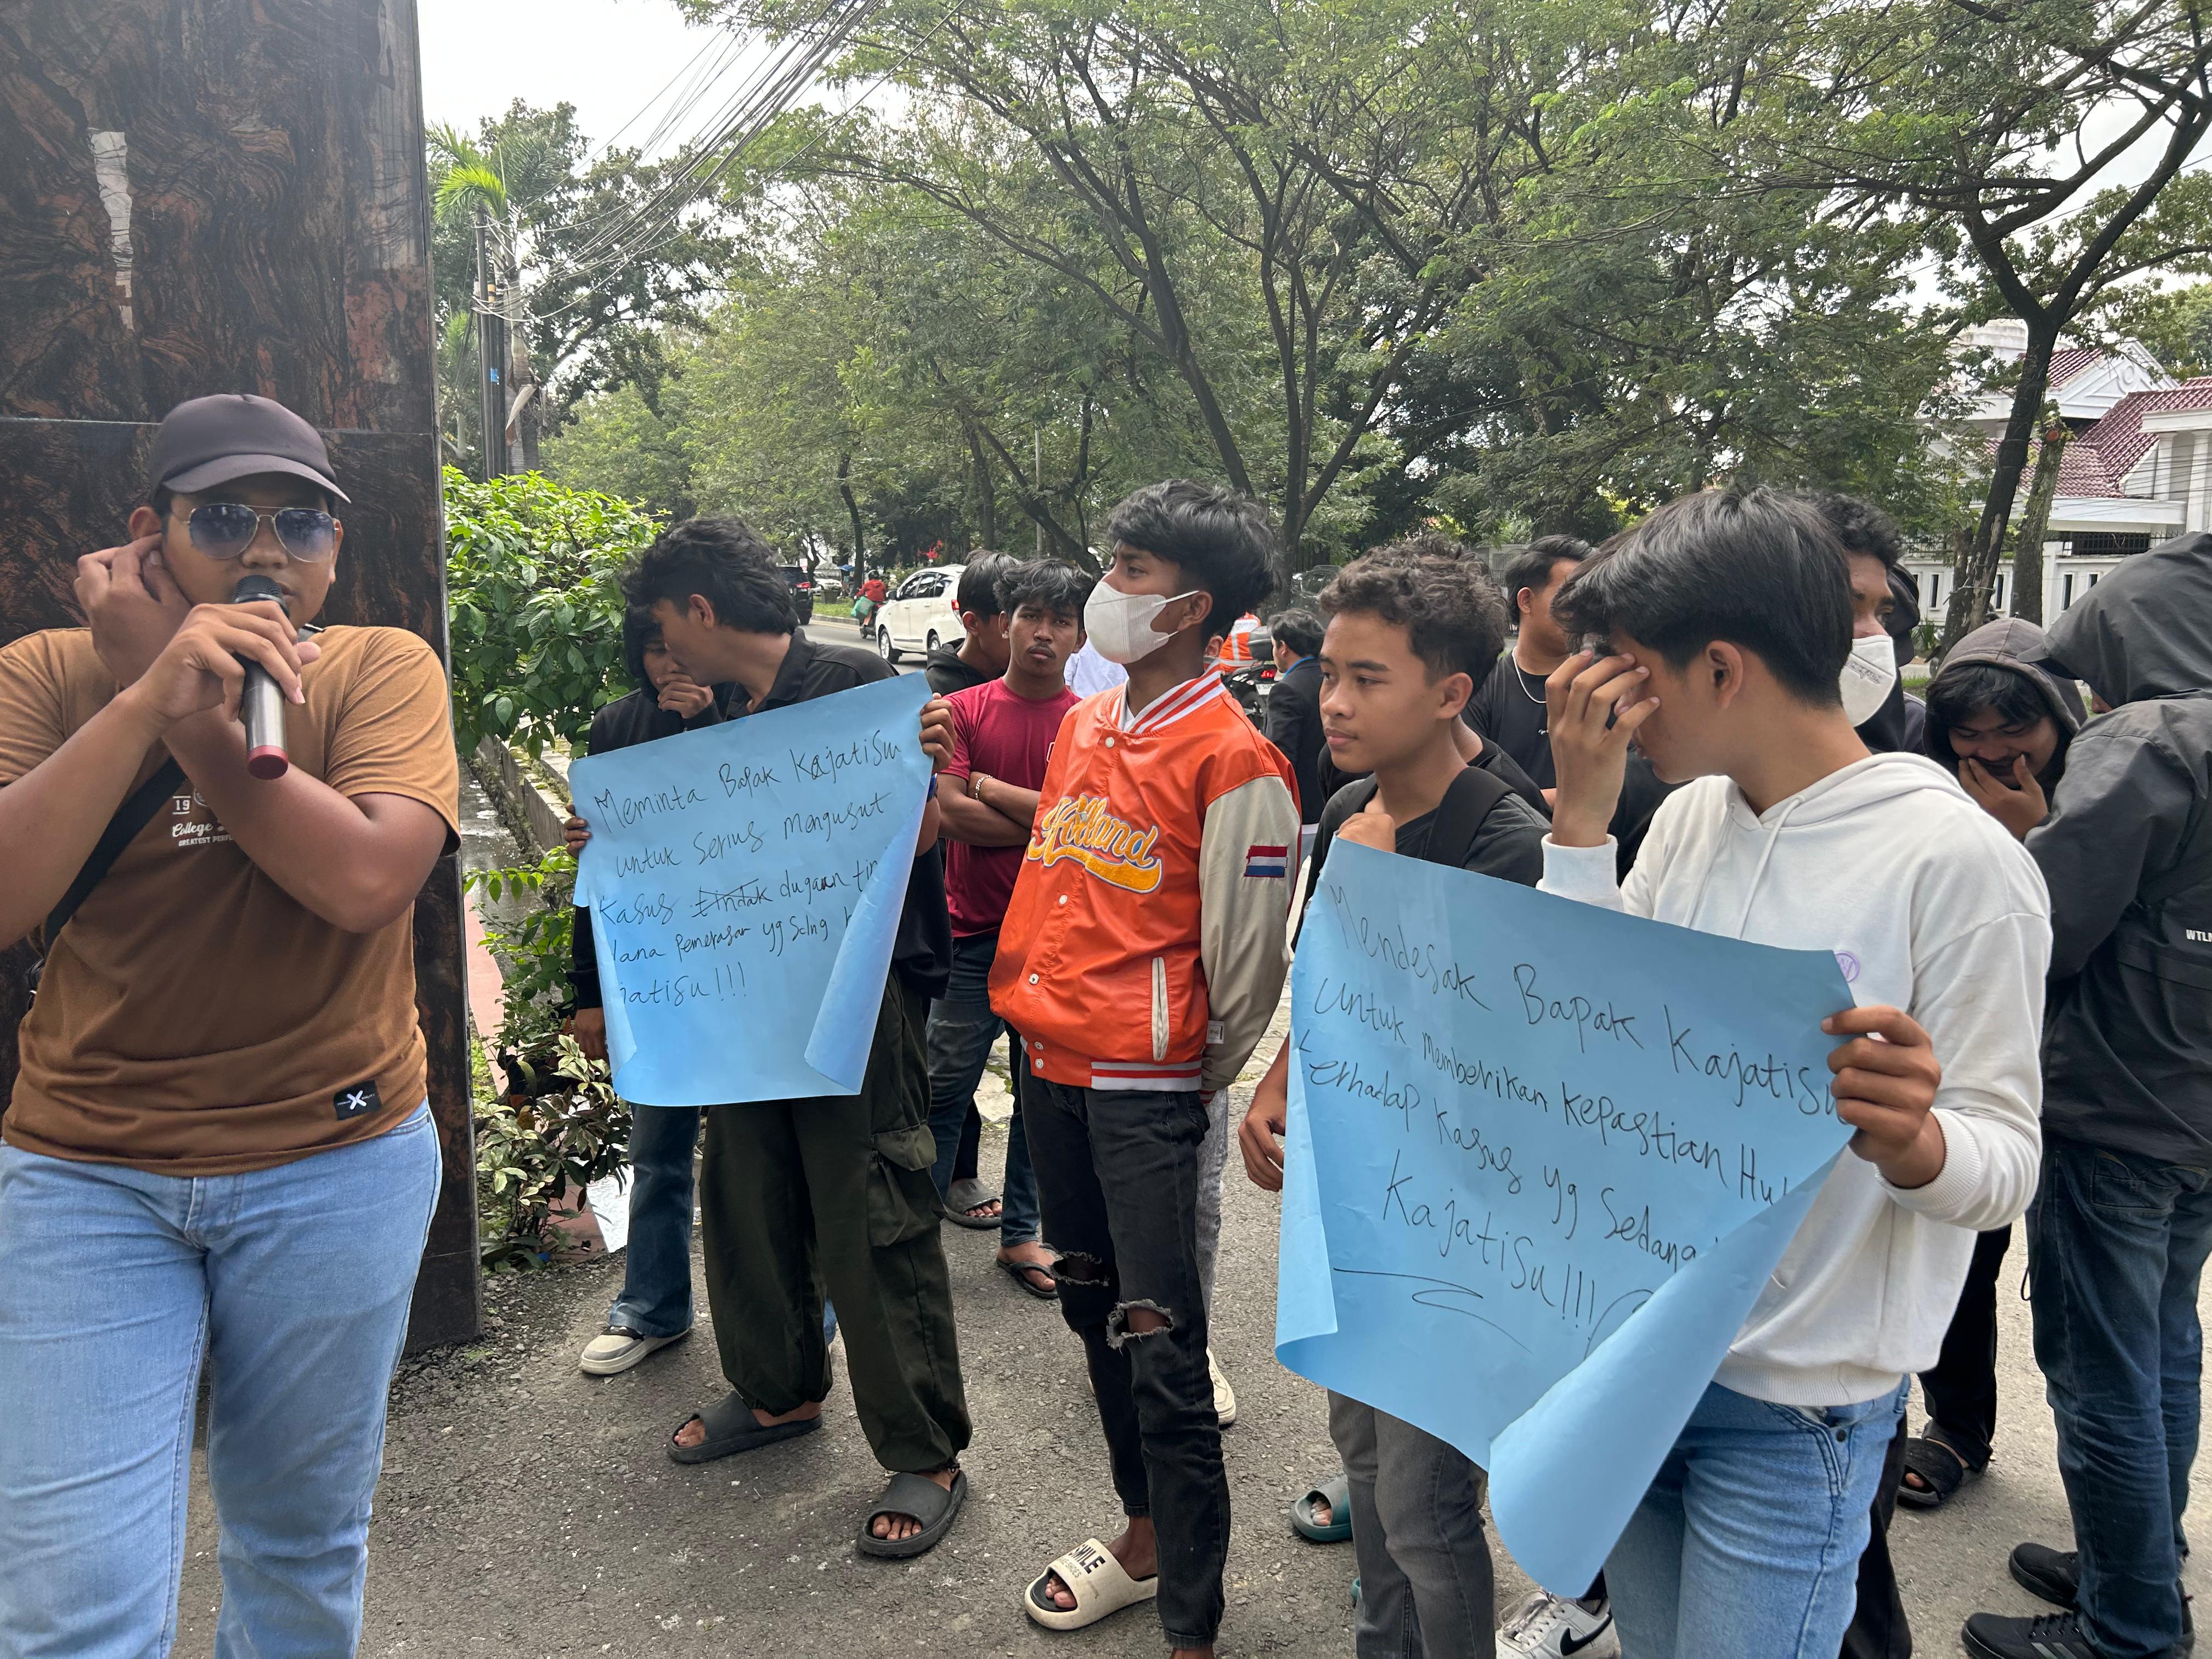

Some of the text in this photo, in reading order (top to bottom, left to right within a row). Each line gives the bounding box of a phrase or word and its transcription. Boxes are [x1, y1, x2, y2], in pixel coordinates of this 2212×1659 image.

[176, 799, 190, 811] 19
[594, 785, 709, 833] Meminta
[172, 822, 213, 838] College
[1513, 963, 1645, 1054] Bapak
[1543, 1164, 1578, 1240] yg
[1068, 1544, 1106, 1575] SMILE
